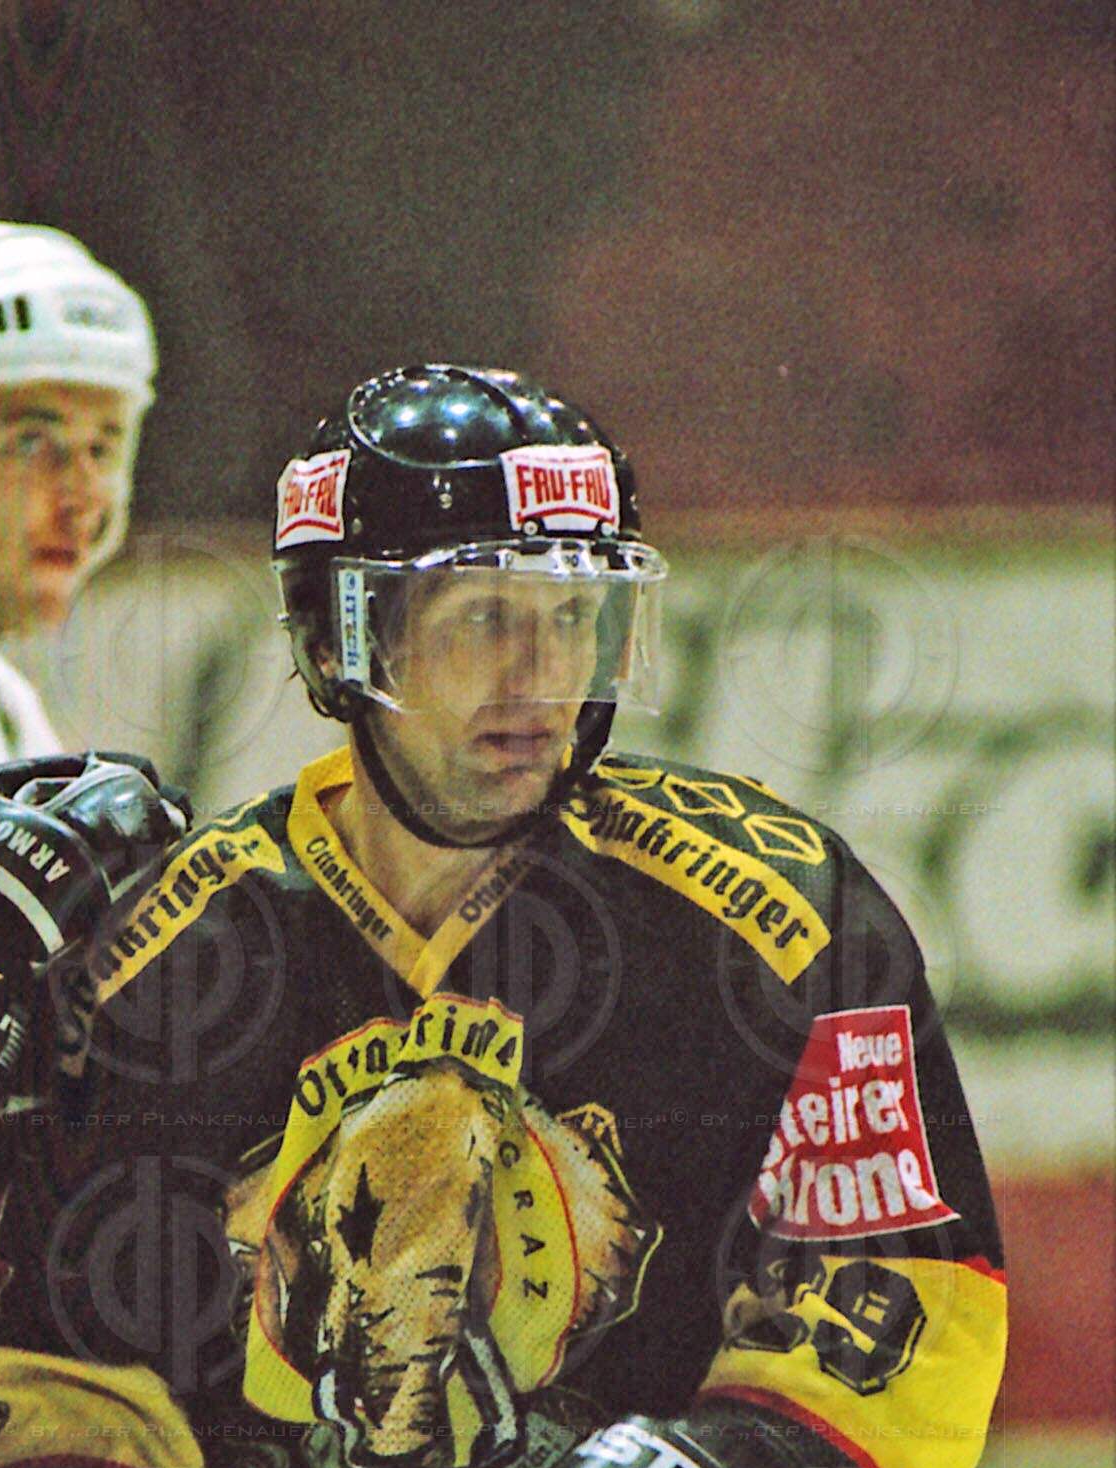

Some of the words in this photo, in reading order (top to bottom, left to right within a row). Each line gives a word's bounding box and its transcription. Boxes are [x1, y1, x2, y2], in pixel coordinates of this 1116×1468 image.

[514, 463, 613, 508] FRU-FRU
[305, 835, 395, 942] Ottakringer
[837, 1029, 905, 1073] Neue
